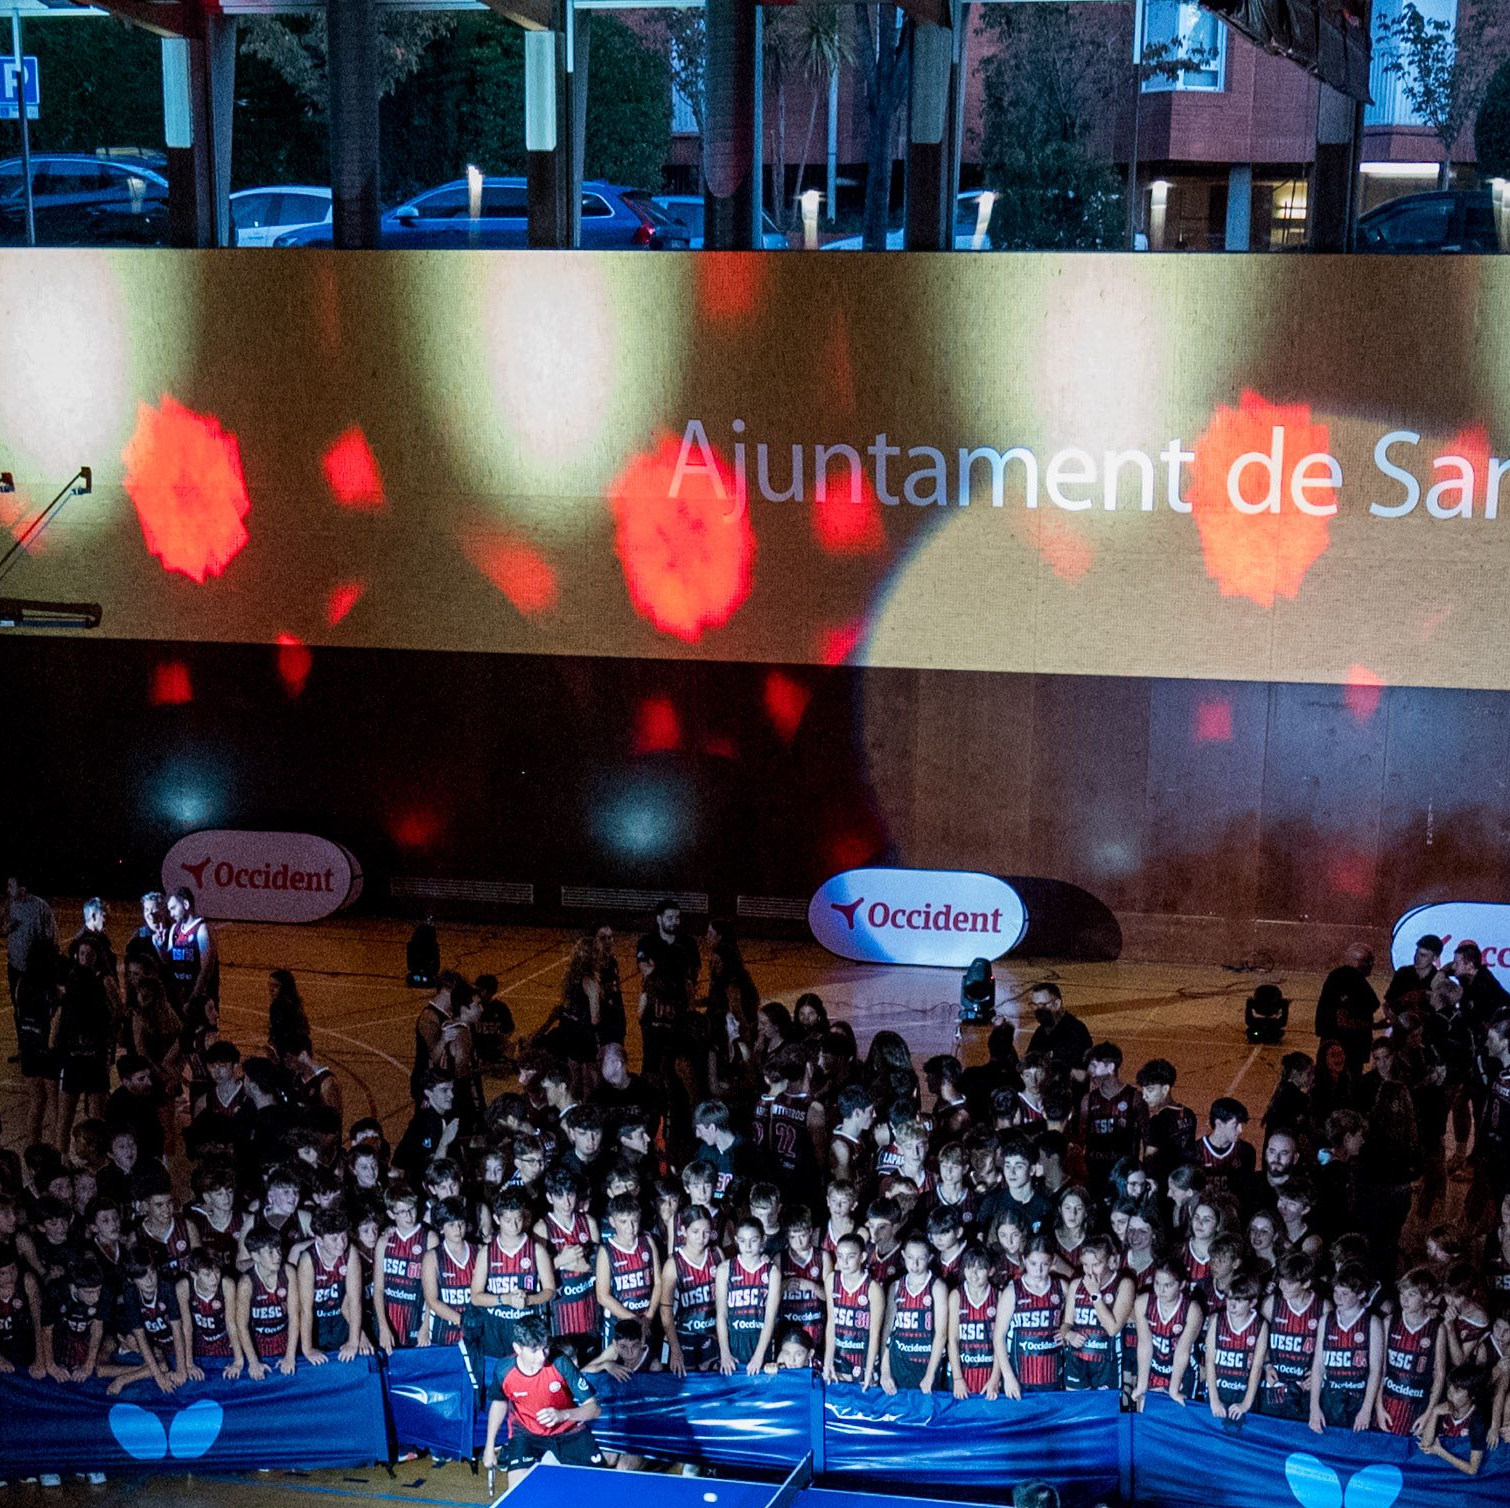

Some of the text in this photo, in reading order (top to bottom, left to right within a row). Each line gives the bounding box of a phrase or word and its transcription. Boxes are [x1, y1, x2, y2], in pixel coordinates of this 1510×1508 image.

[4, 62, 29, 98] P
[668, 419, 1193, 522] Ajuntament
[1227, 426, 1343, 515] de
[214, 861, 334, 892] Occident
[868, 902, 1003, 933] Occident
[615, 1268, 643, 1291] UESC
[441, 1288, 471, 1306] UESC
[728, 1289, 758, 1308] UESC
[252, 1307, 282, 1320] UESC
[1012, 1311, 1049, 1329] UESC
[1271, 1342, 1302, 1363] UESC
[1387, 1378, 1423, 1398] Occident
